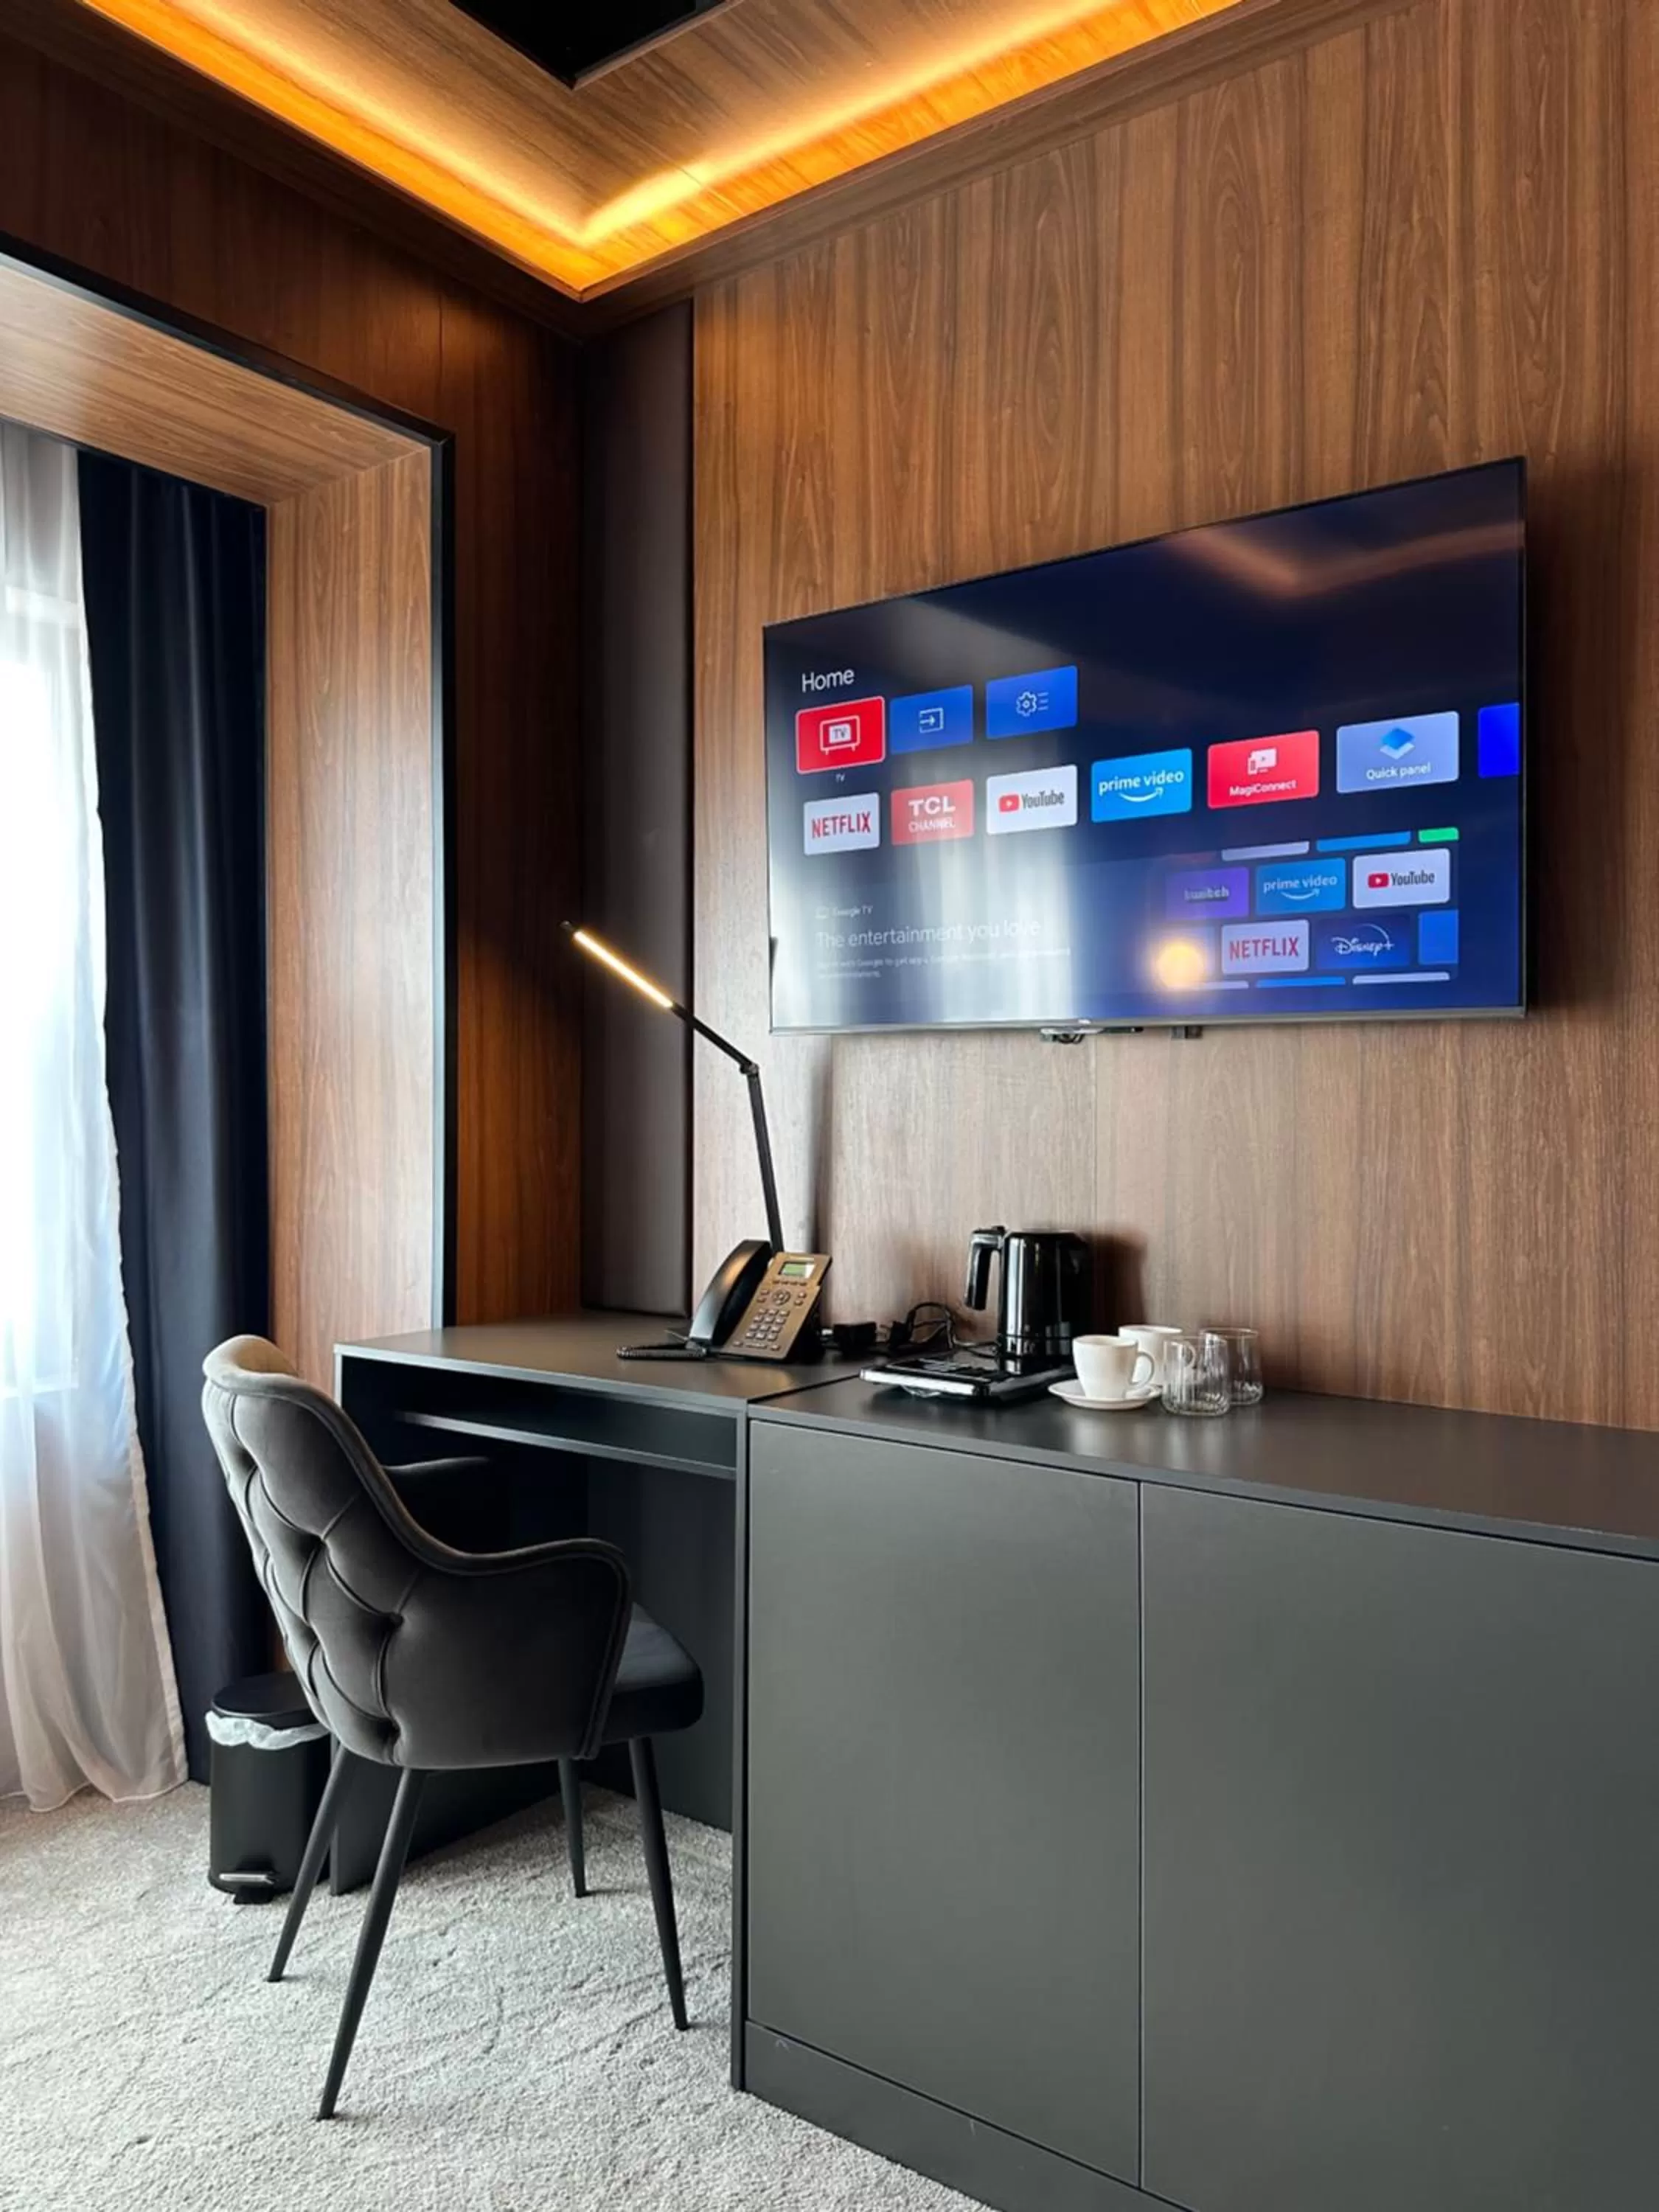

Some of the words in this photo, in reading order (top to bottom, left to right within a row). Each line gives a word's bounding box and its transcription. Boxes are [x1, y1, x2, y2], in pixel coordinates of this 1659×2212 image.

[801, 668, 855, 693] Home
[835, 773, 846, 783] TV
[1366, 768, 1398, 781] Quick
[1400, 762, 1432, 778] panel
[1099, 776, 1141, 796] prime
[1144, 770, 1184, 786] video
[1229, 779, 1297, 797] MagiConnect
[908, 796, 956, 817] TCL
[1021, 790, 1065, 809] YouTube
[811, 812, 871, 838] NETFLIX
[1263, 877, 1299, 894] prime
[1302, 874, 1338, 888] video
[1391, 870, 1435, 886] YouTube
[815, 931, 844, 948] The
[849, 925, 962, 947] entertainment
[967, 922, 1000, 945] you
[1004, 919, 1041, 937] love
[1228, 936, 1299, 958] NETFLIX
